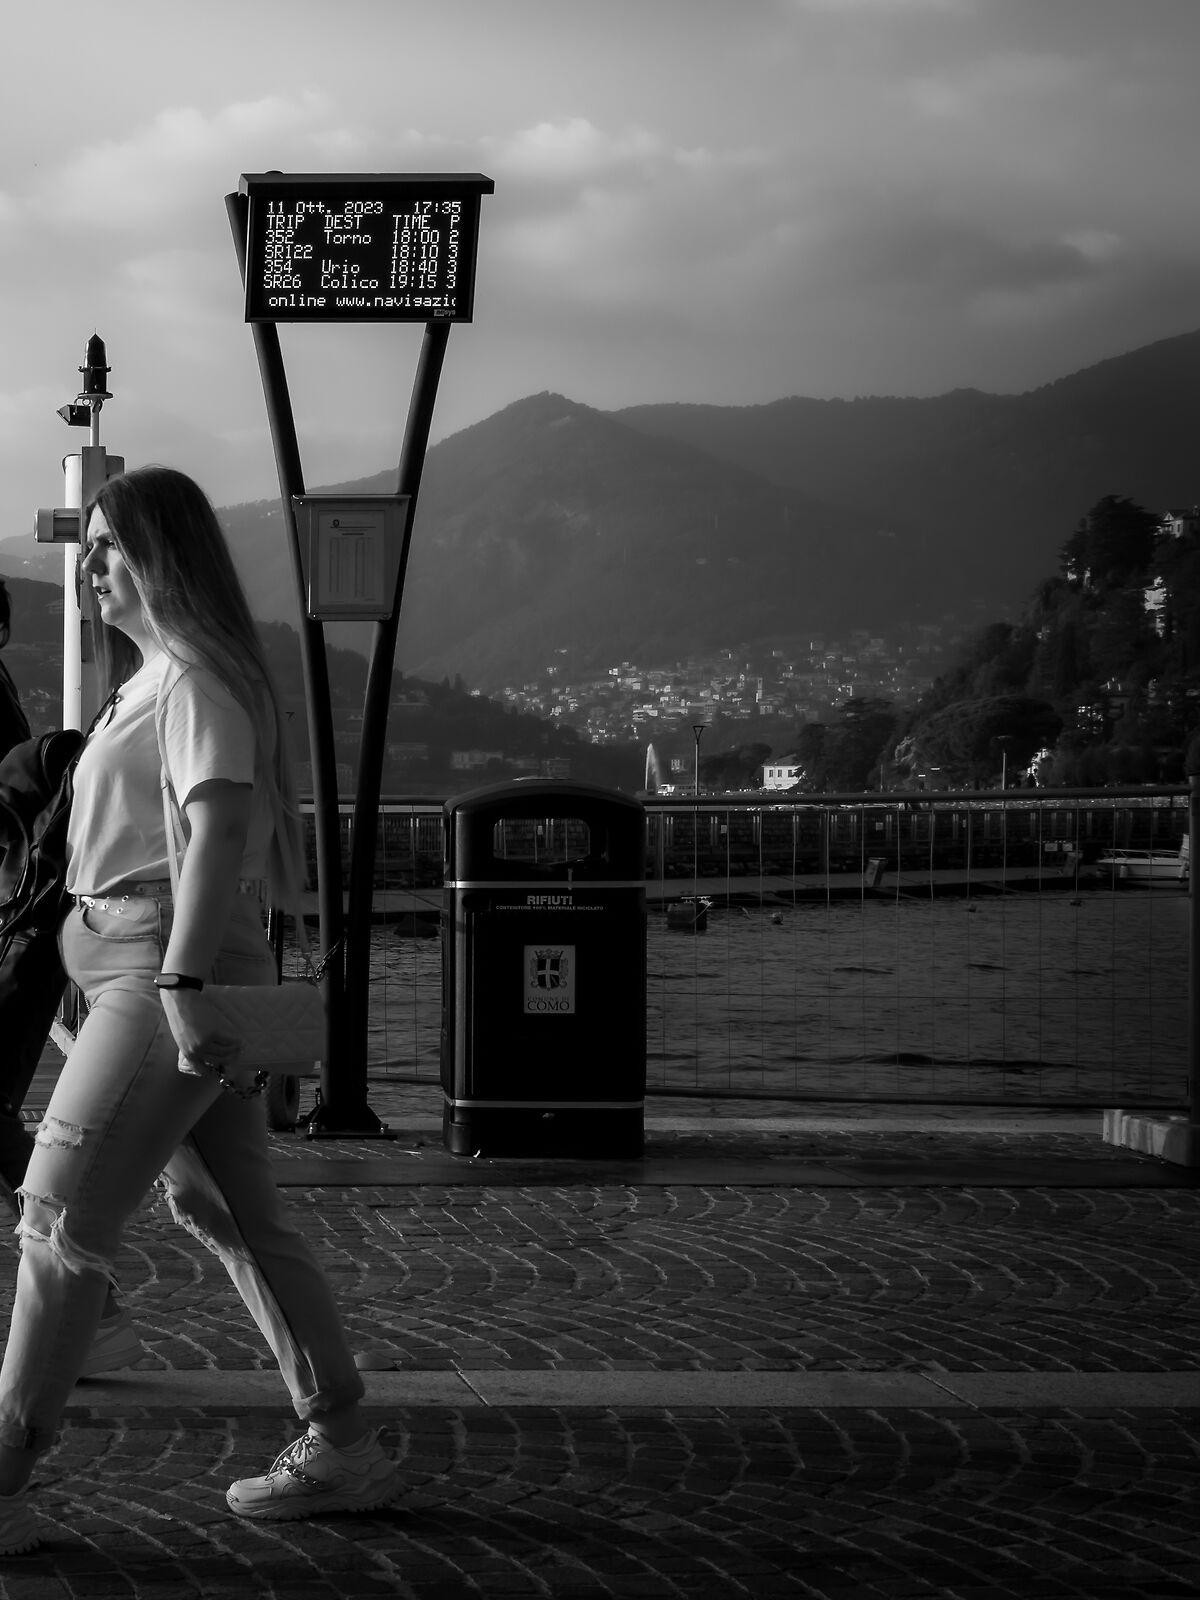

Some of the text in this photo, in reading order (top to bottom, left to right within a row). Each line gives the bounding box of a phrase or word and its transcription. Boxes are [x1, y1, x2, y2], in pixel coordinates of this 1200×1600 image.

[268, 201, 461, 214] 11 Ott. 2023 17:35
[267, 214, 460, 229] TRIP DEST TIME P
[266, 229, 459, 244] 352 Torno 18:00 2
[265, 245, 458, 259] SR122 18:10 3
[264, 260, 457, 274] 354 Urio 18:40 3
[264, 275, 456, 289] SR26 Colico 19:15 3
[269, 294, 326, 306] online
[527, 895, 573, 905] RIFIUTI
[527, 1000, 569, 1011] COMO
